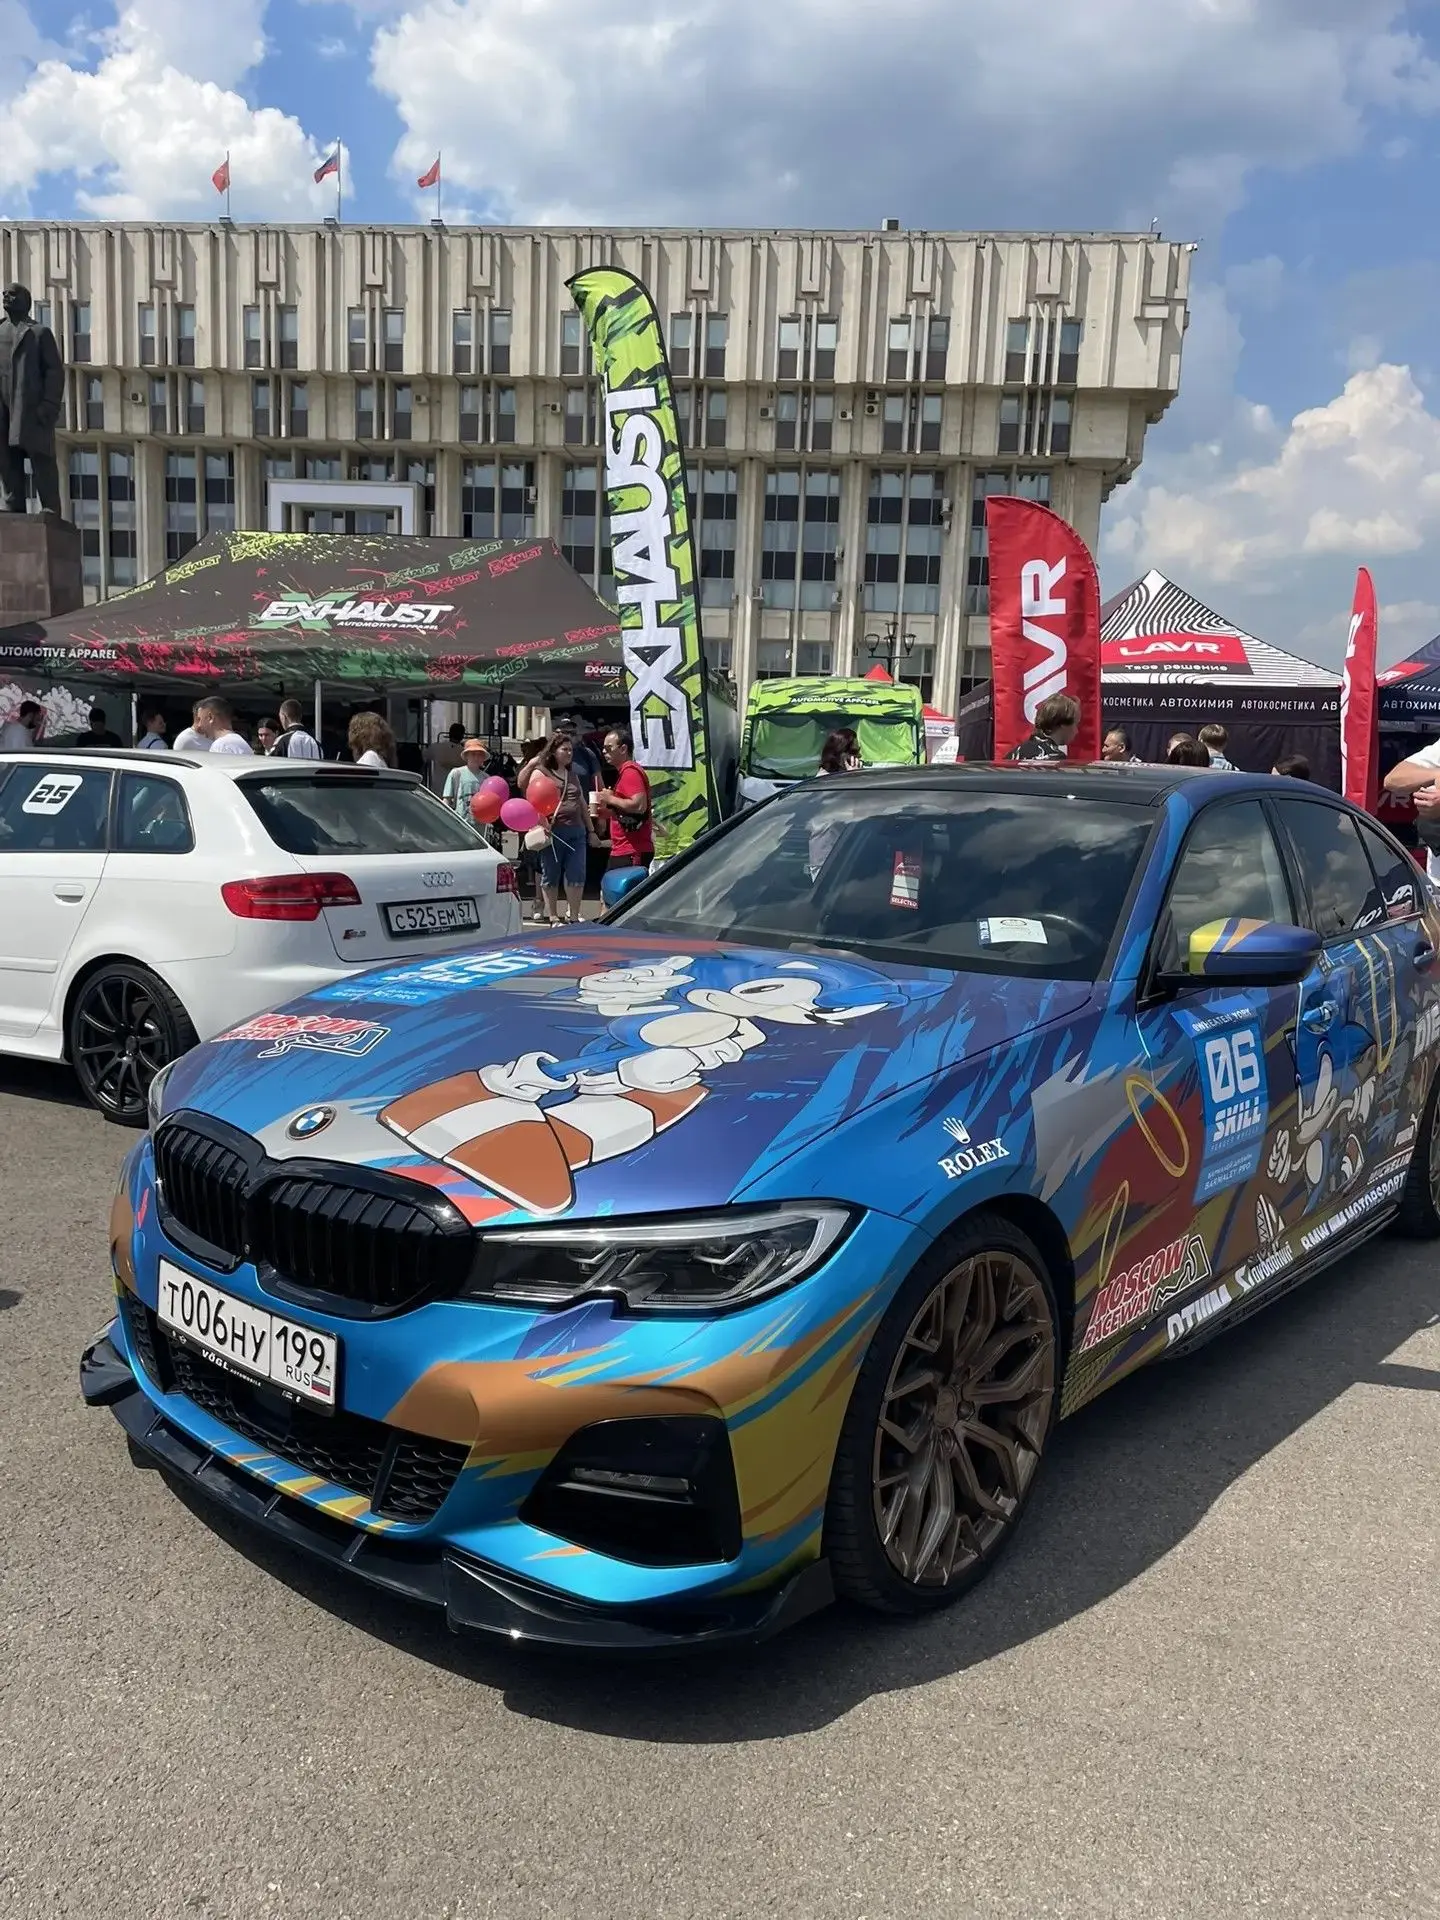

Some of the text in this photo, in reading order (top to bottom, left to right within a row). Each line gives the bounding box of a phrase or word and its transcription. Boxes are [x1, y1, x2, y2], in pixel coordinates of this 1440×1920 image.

[606, 388, 693, 769] EXHAUST
[258, 599, 454, 625] EXHAUST
[336, 620, 397, 628] AUTOMOTIVE
[68, 648, 118, 659] APPAREL
[1119, 641, 1220, 656] LAVR
[584, 665, 623, 674] EXHAUST
[845, 697, 880, 705] APPAREL
[1101, 697, 1154, 707] КОСМЕТИКА
[1160, 698, 1234, 709] АВТОХИМИЯ
[1241, 699, 1316, 711] АВТОКОСМЕТИКА
[29, 784, 76, 804] 25
[457, 902, 470, 918] 57
[1204, 1029, 1261, 1104] 06
[1212, 1096, 1262, 1142] SKILL
[937, 1137, 1010, 1179] ROLEX
[1345, 1171, 1407, 1220] MOTORSPORT
[1090, 1234, 1190, 1320] MOSCOW
[1079, 1287, 1153, 1354] RACEWAY
[275, 1325, 326, 1376] 199
[285, 1365, 311, 1387] RUS
